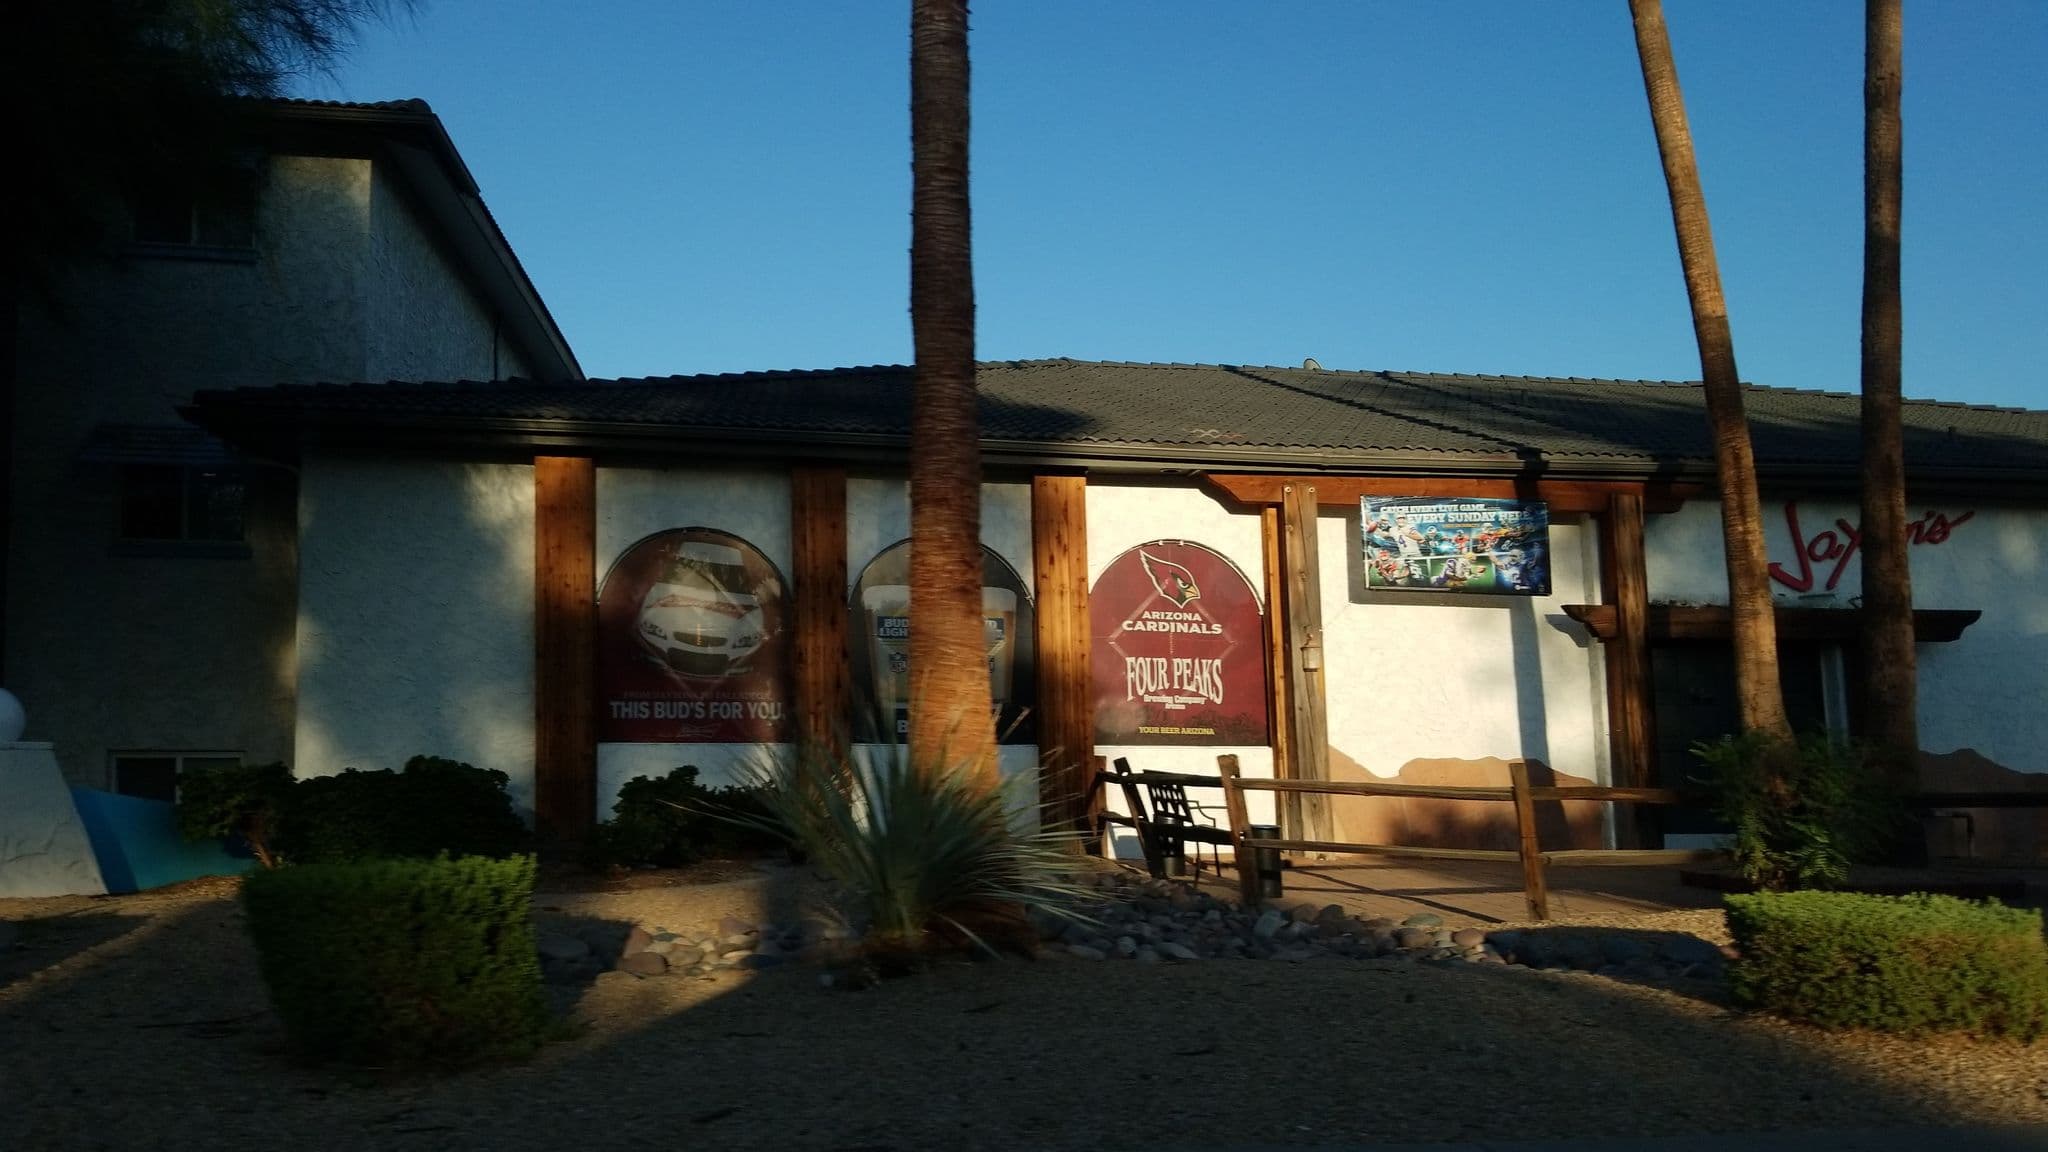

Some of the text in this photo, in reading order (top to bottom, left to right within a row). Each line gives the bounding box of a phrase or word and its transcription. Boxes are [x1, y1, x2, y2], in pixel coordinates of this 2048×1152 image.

[1411, 505, 1438, 513] EVERY
[1406, 513, 1446, 524] EVERY
[1448, 512, 1497, 523] SUNDAY
[1141, 611, 1202, 621] ARIZONA
[879, 628, 908, 637] LIGH
[1122, 621, 1223, 635] CARDINALS
[1125, 657, 1223, 705] FOUR PEAKS
[609, 701, 650, 719] THIS
[654, 701, 705, 719] BUD'S
[709, 701, 743, 720] FOR
[1138, 726, 1160, 734] YOUR
[1181, 727, 1216, 736] ARIZONA
